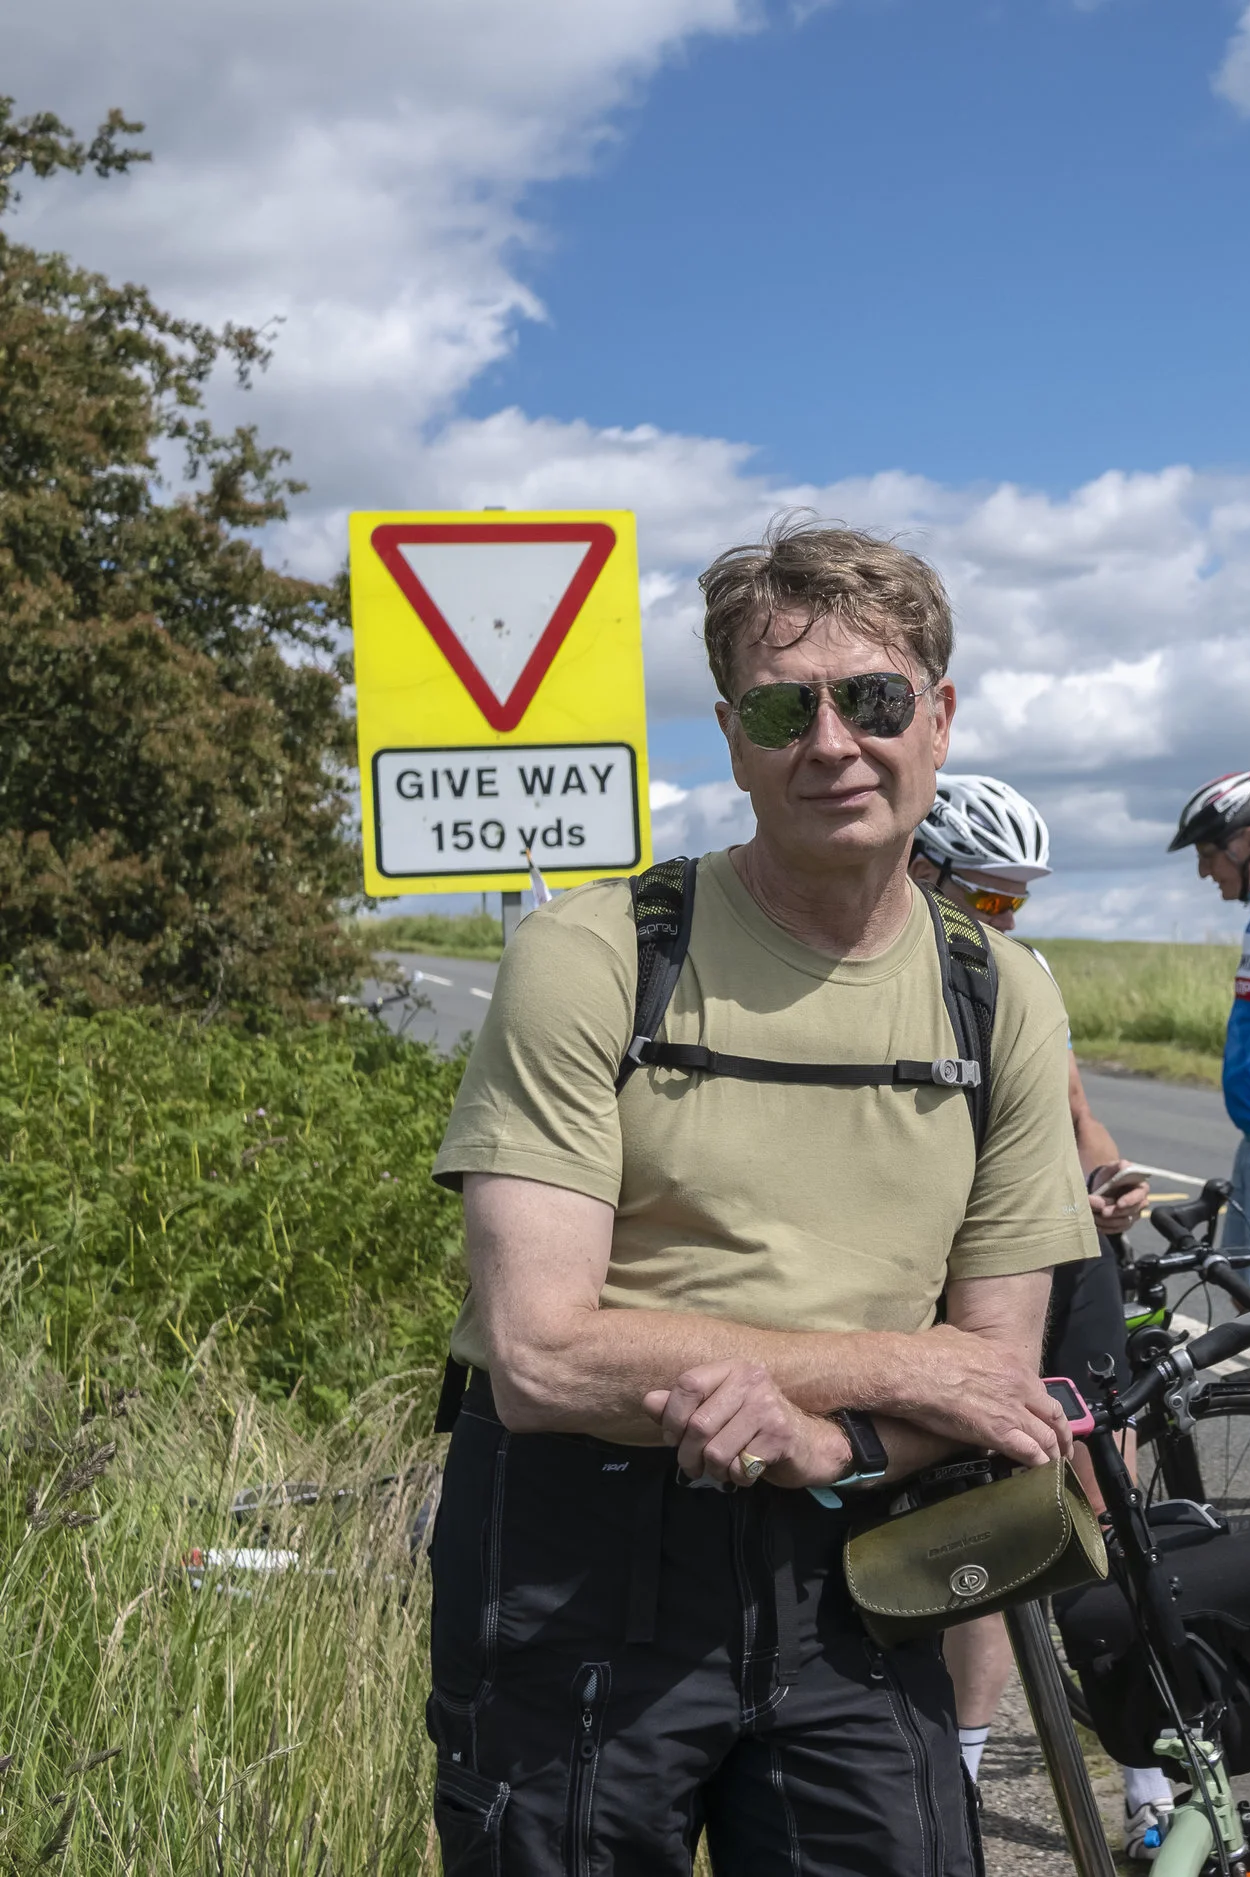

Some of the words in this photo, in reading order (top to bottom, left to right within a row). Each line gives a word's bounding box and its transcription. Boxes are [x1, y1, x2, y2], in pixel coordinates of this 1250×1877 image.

[397, 766, 499, 800] GIVE
[519, 764, 615, 796] WAY
[431, 820, 506, 851] 150
[518, 818, 586, 856] yds
[636, 923, 678, 936] sprey
[935, 1463, 977, 1480] BROOKS
